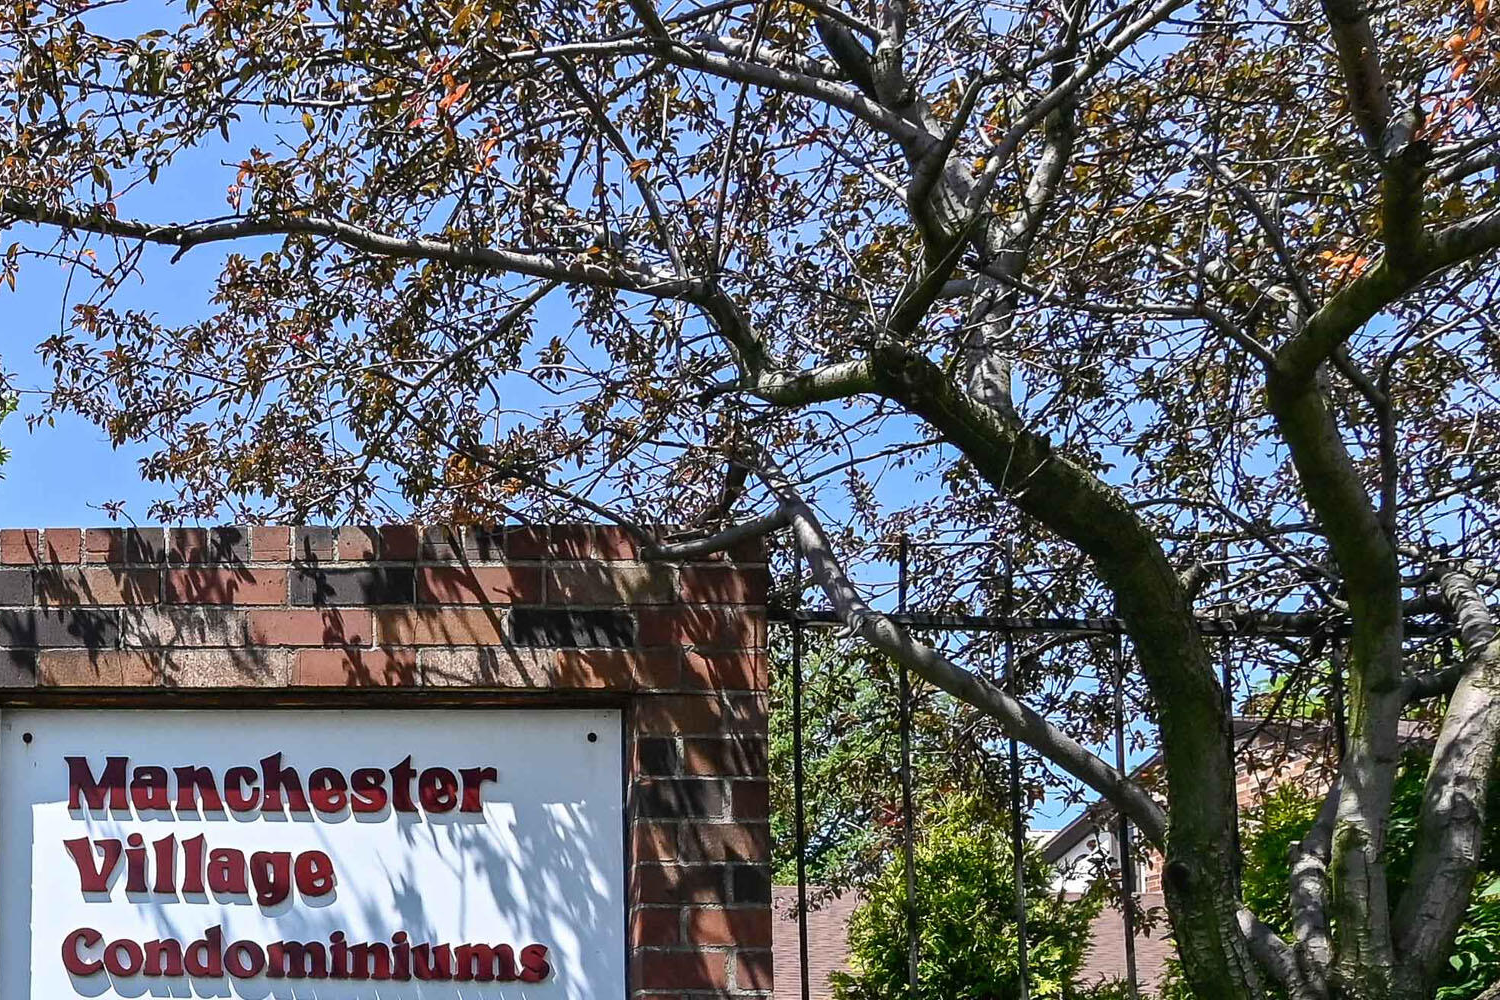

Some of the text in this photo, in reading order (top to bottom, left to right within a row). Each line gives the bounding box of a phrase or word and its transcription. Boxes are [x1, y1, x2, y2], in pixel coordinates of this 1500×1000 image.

[65, 752, 496, 814] Manchester
[63, 832, 335, 906] Village
[61, 924, 552, 982] Condominiums
